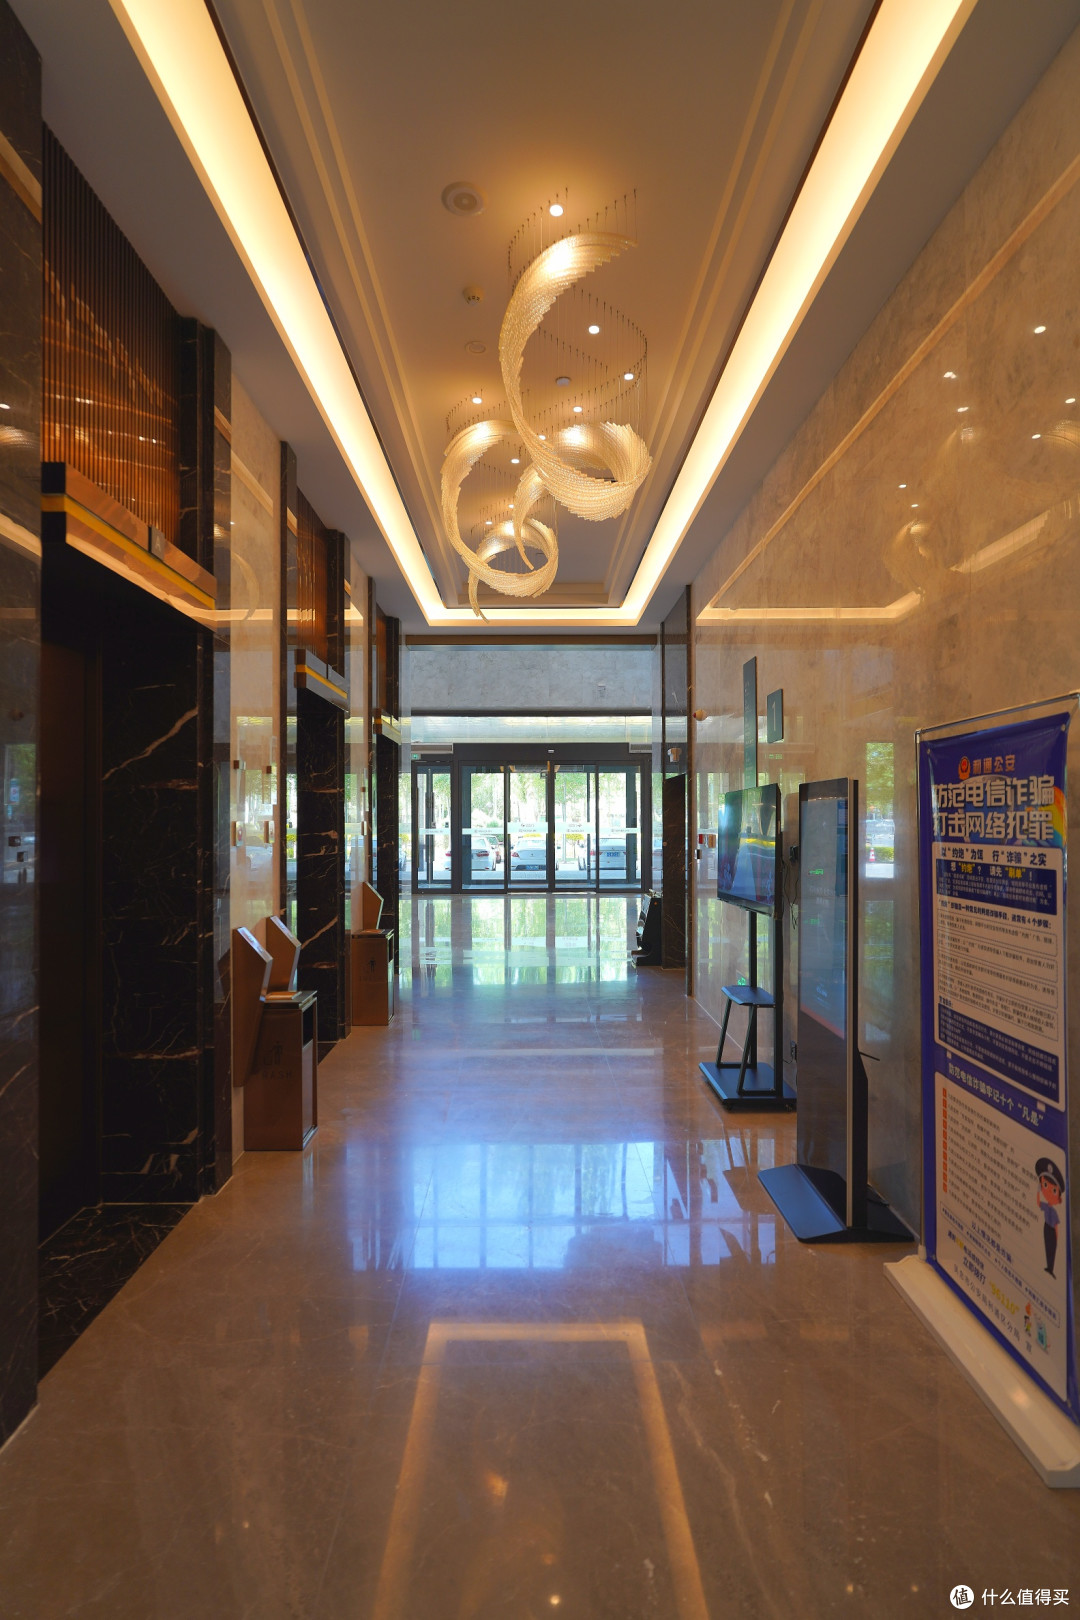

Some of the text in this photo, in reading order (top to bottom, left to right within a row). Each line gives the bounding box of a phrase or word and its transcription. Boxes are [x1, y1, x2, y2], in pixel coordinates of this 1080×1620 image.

[933, 775, 1055, 809] 防范电信诈骗
[933, 809, 1055, 841] 打击网络犯罪
